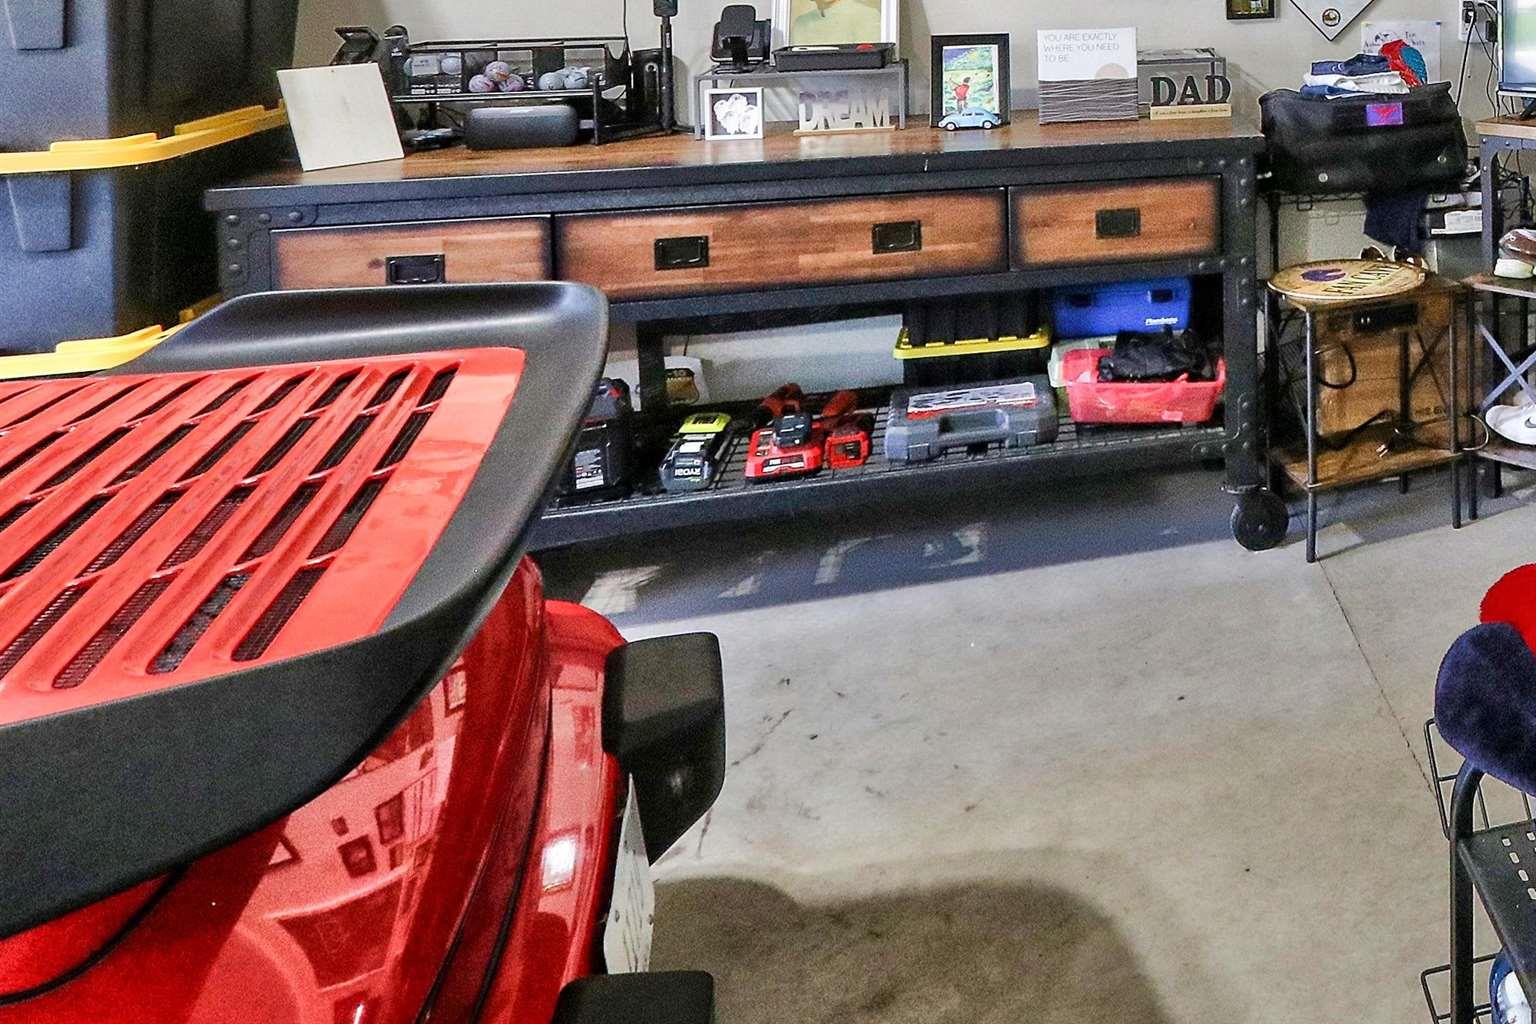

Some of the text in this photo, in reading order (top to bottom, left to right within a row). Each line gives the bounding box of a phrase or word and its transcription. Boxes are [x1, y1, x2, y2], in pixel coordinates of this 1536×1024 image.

[1043, 31, 1118, 43] YOU ARE EXACTLY
[1043, 42, 1120, 53] WHERE YOU NEED
[1044, 54, 1070, 63] TO BE
[1150, 75, 1231, 107] DAD
[799, 90, 890, 130] DREAM
[674, 467, 701, 477] RYOBI
